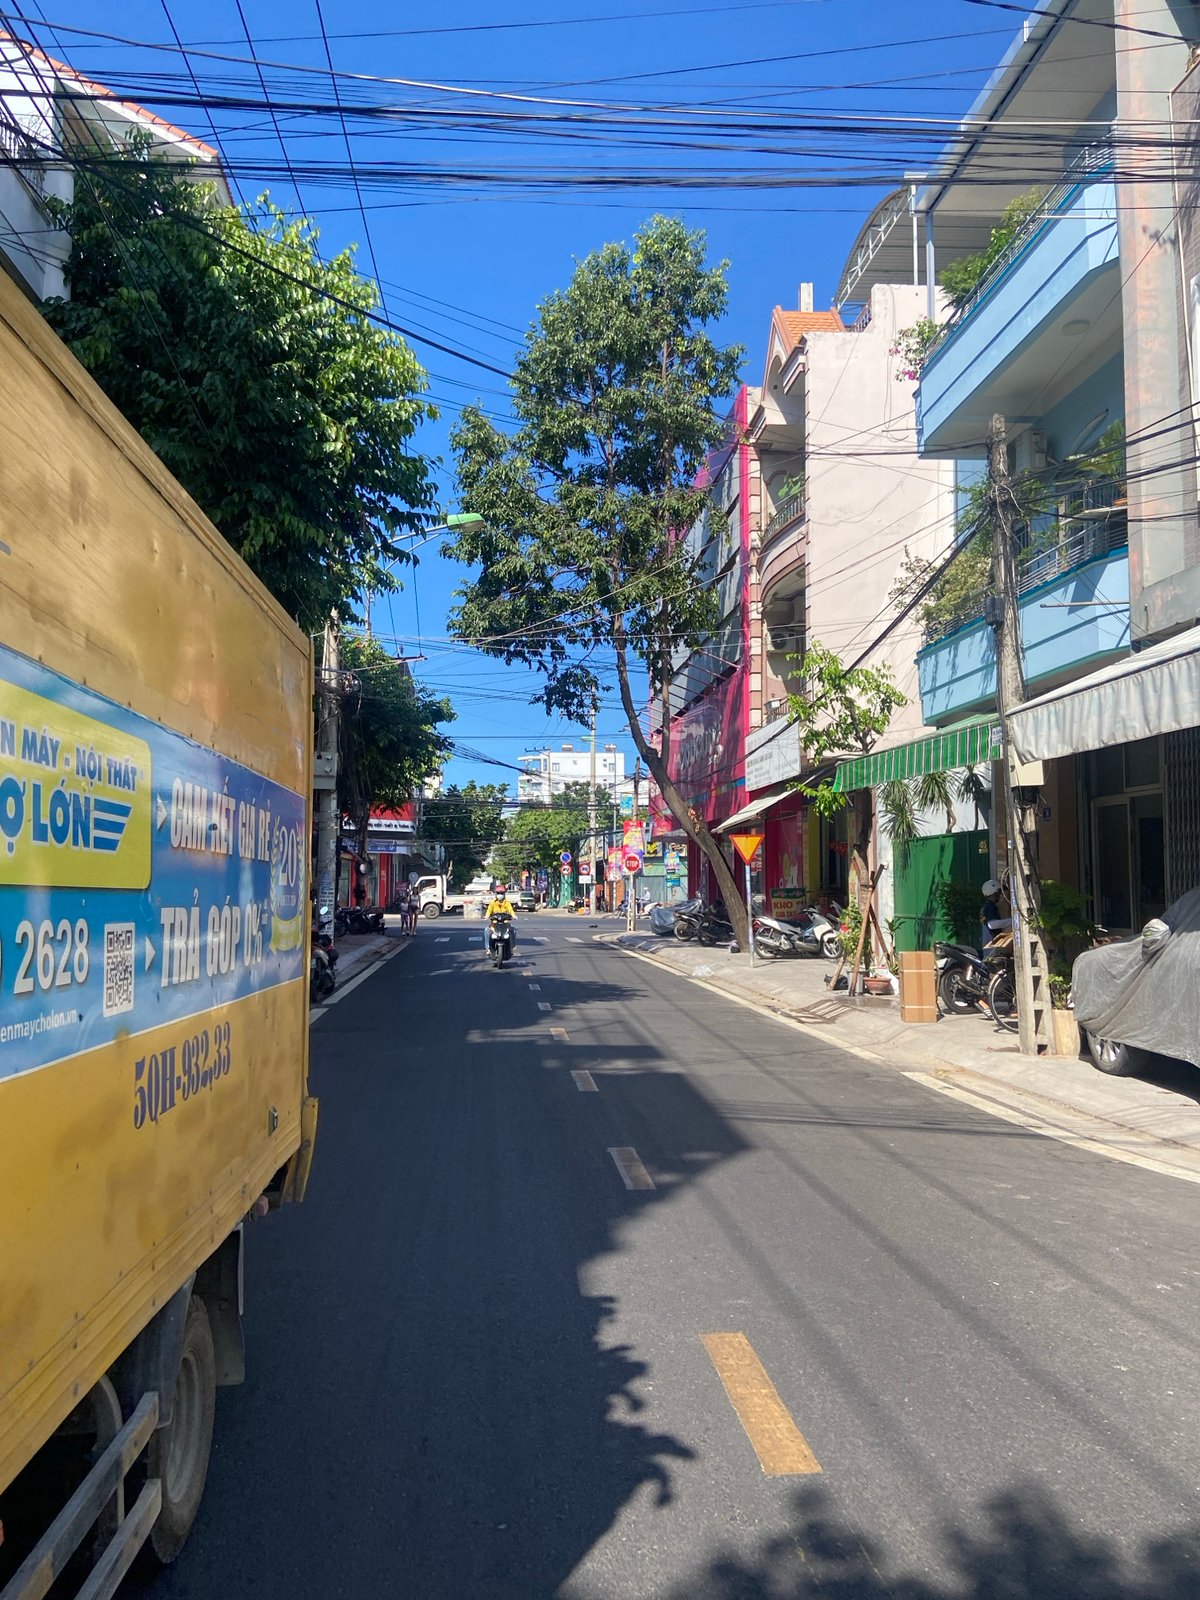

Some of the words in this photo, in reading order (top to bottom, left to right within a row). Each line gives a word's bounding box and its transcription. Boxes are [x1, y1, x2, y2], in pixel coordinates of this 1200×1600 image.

[22, 728, 60, 769] MÁY
[75, 746, 102, 787] NỘI
[106, 756, 137, 791] THẤT
[32, 778, 92, 849] LỚN
[211, 775, 236, 855] KẾT
[238, 797, 255, 859] GIÁ
[258, 799, 271, 861] RẺ
[279, 825, 298, 888] 20
[160, 887, 200, 987] TRẢ
[206, 896, 241, 978] GÓP
[243, 901, 263, 967] 0%
[773, 901, 793, 909] KHO
[13, 918, 89, 994] 2628
